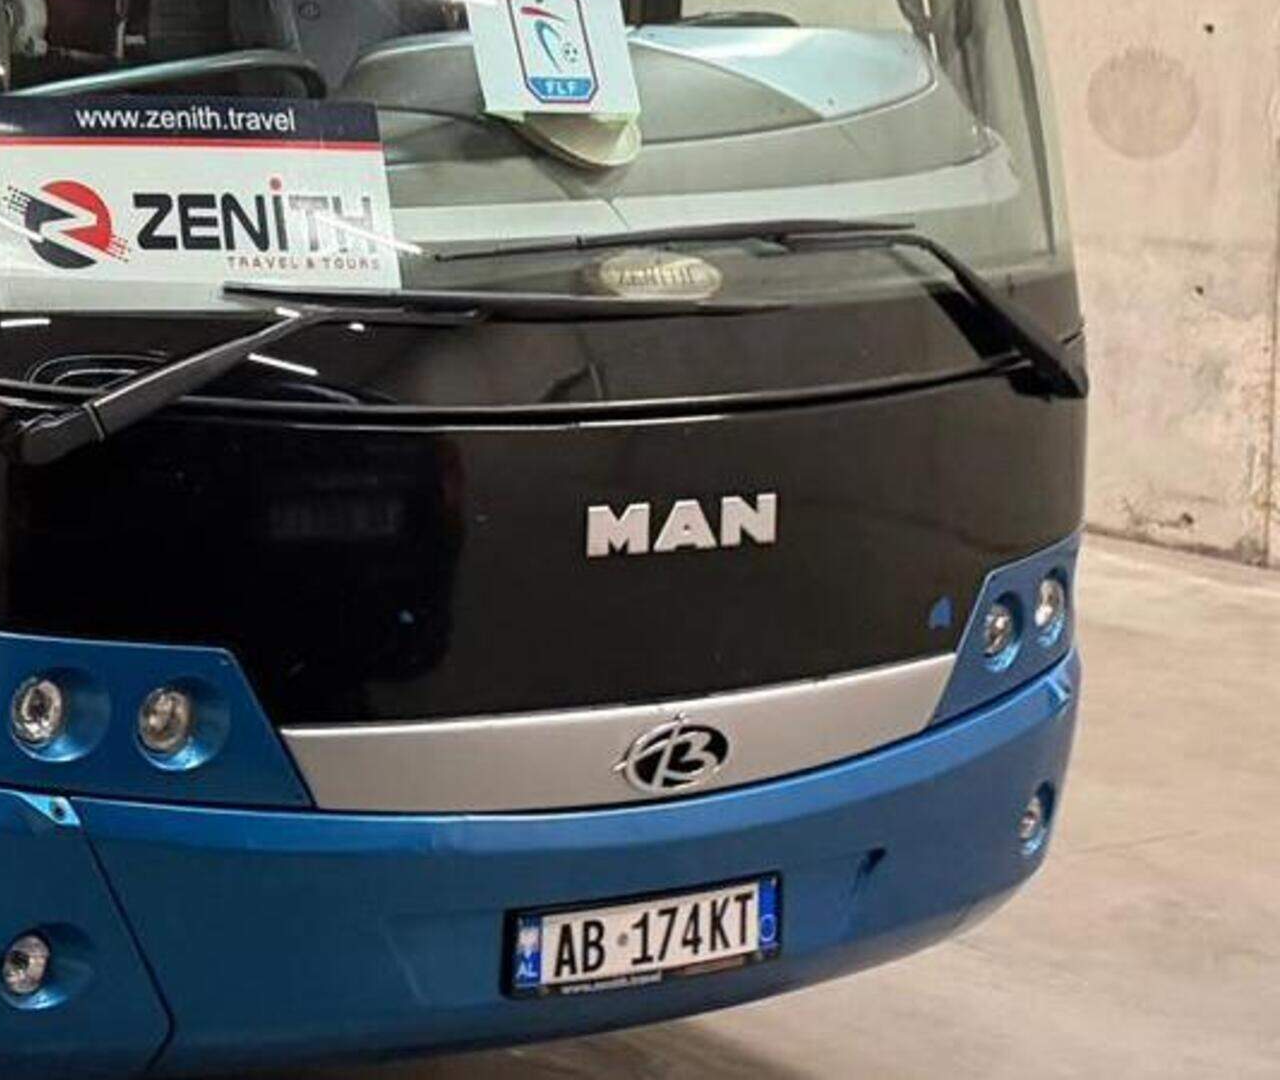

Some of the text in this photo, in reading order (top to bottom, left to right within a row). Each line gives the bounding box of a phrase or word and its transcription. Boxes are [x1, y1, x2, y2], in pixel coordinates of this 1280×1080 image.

[76, 107, 296, 132] www.zenith.travel
[227, 256, 299, 269] TRAVEL
[322, 257, 381, 270] TOURS
[587, 493, 777, 557] MAN
